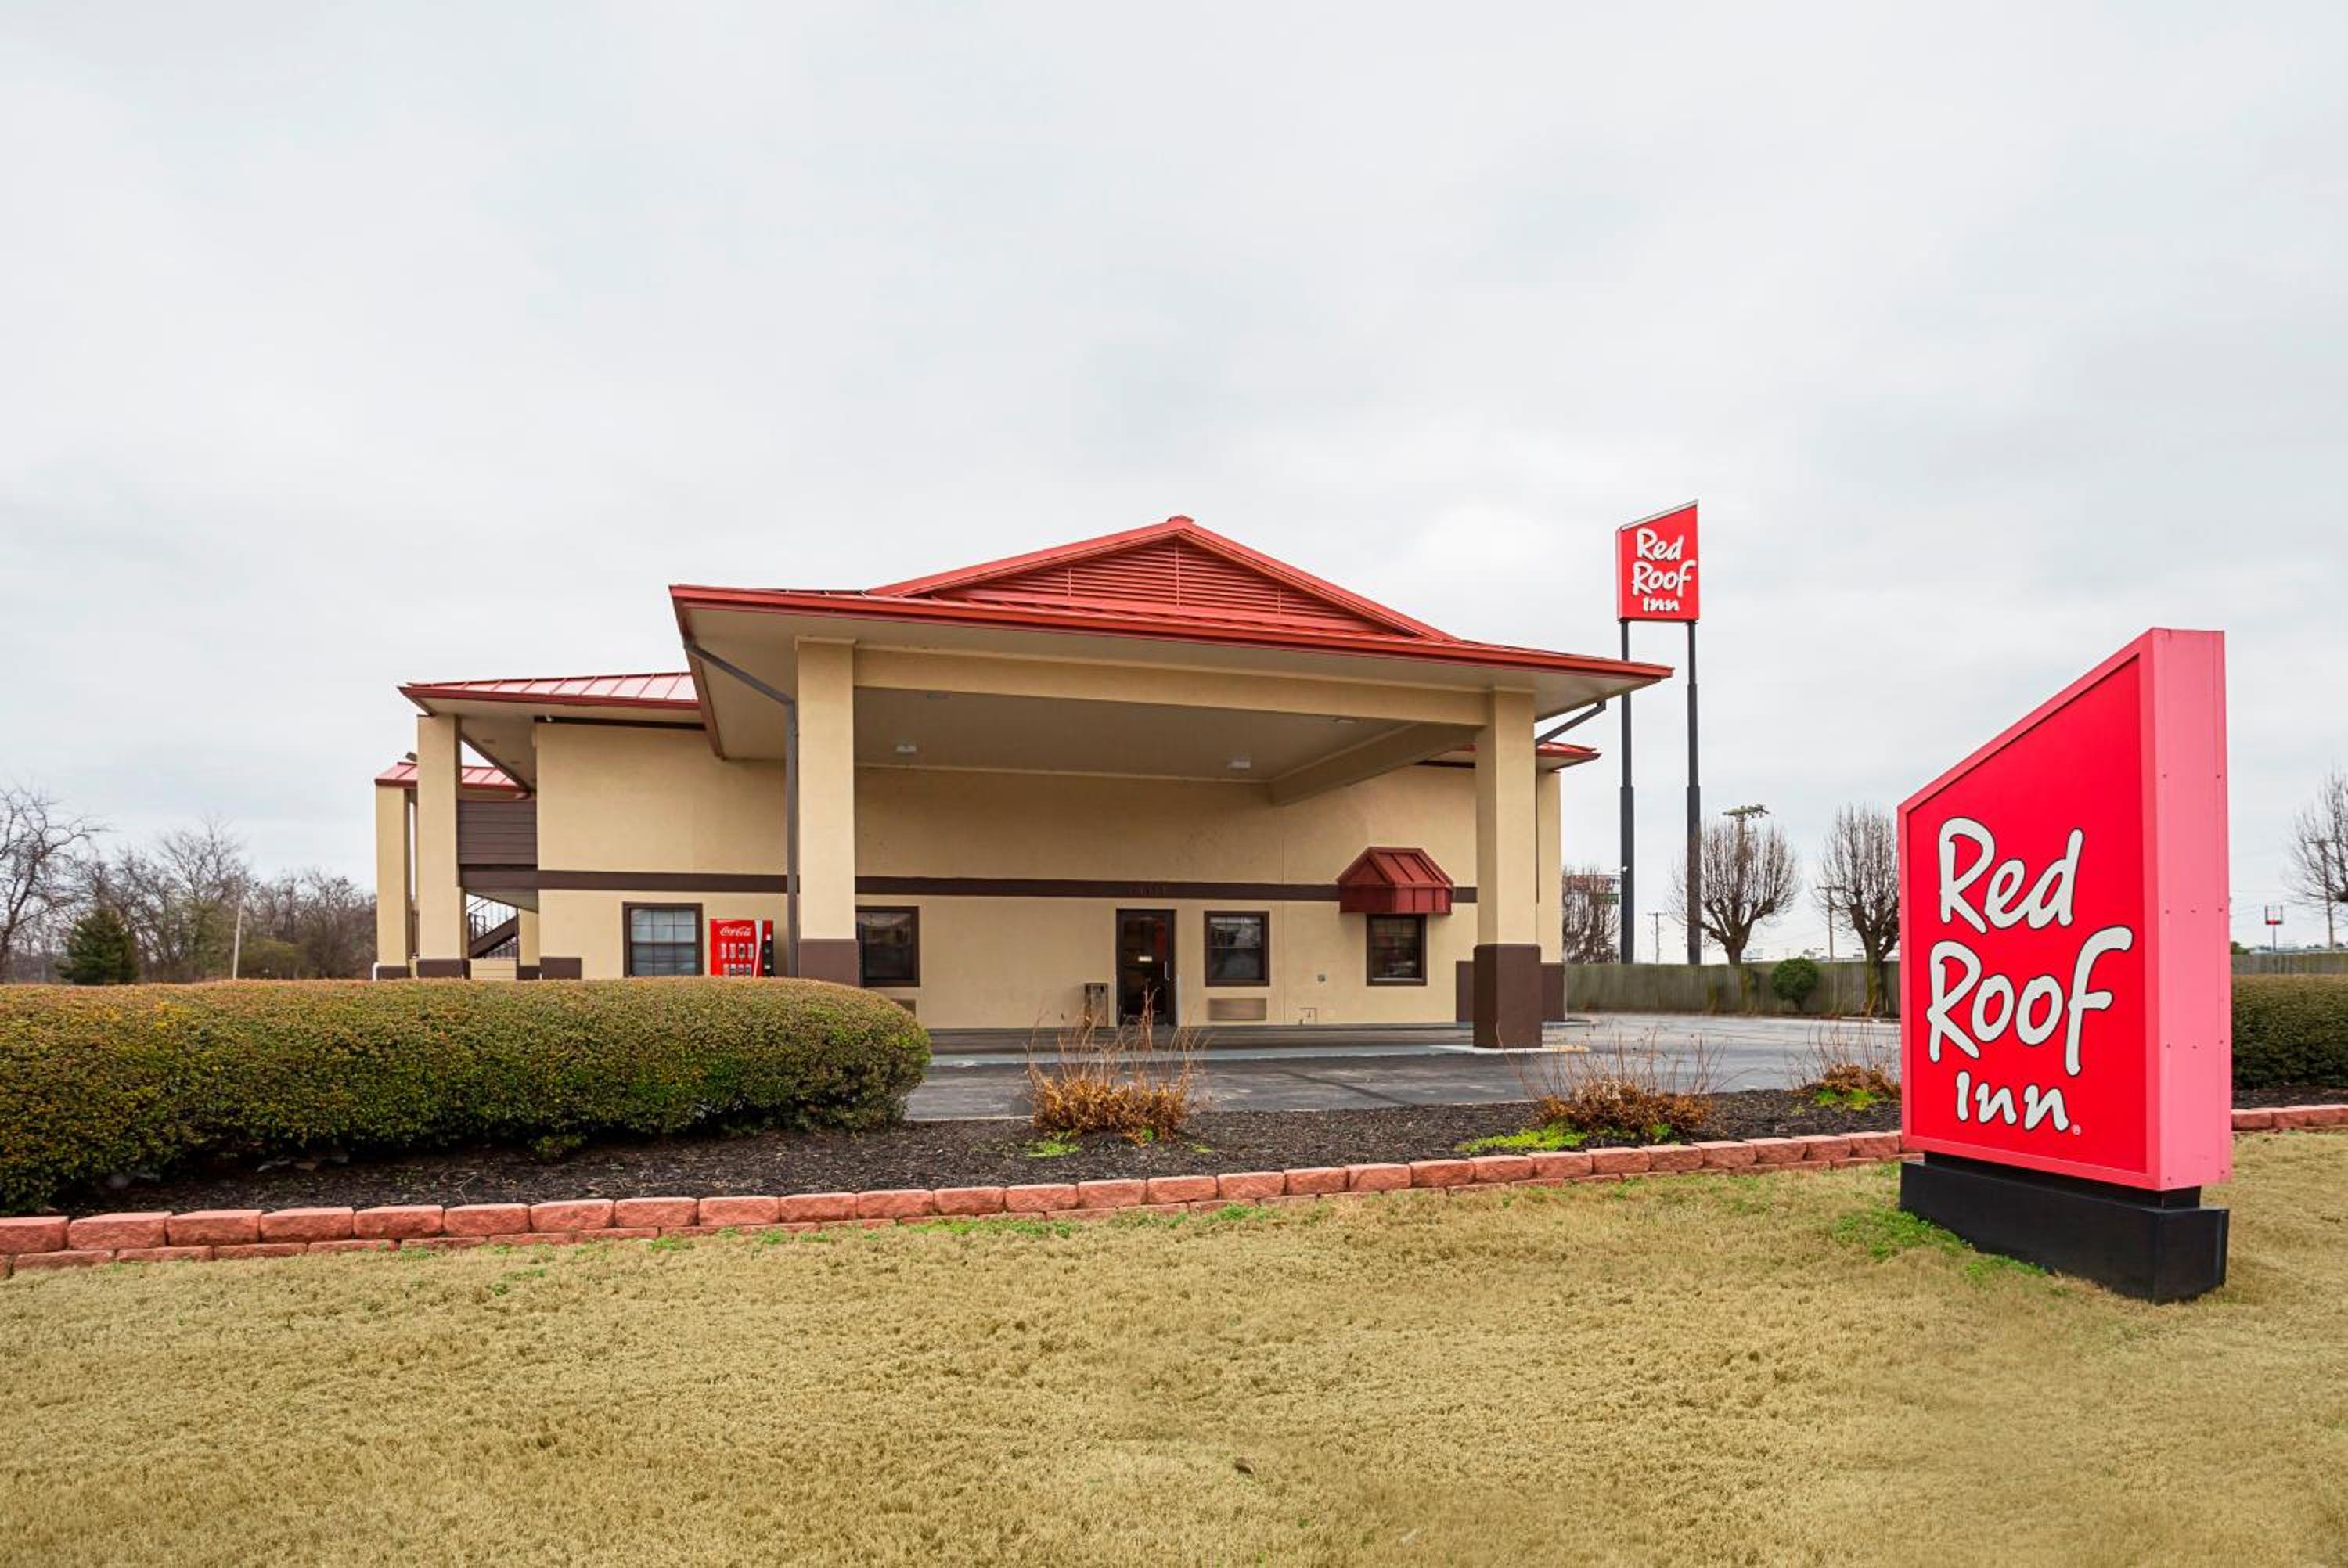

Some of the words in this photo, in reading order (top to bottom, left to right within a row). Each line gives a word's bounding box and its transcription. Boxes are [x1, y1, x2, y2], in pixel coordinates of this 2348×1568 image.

[1637, 527, 1684, 561] Red
[1632, 560, 1696, 598] Roof
[1643, 597, 1679, 612] Inn
[1938, 817, 2084, 933] Red
[1927, 926, 2134, 1076] Roof
[1956, 1070, 2069, 1131] Inn
